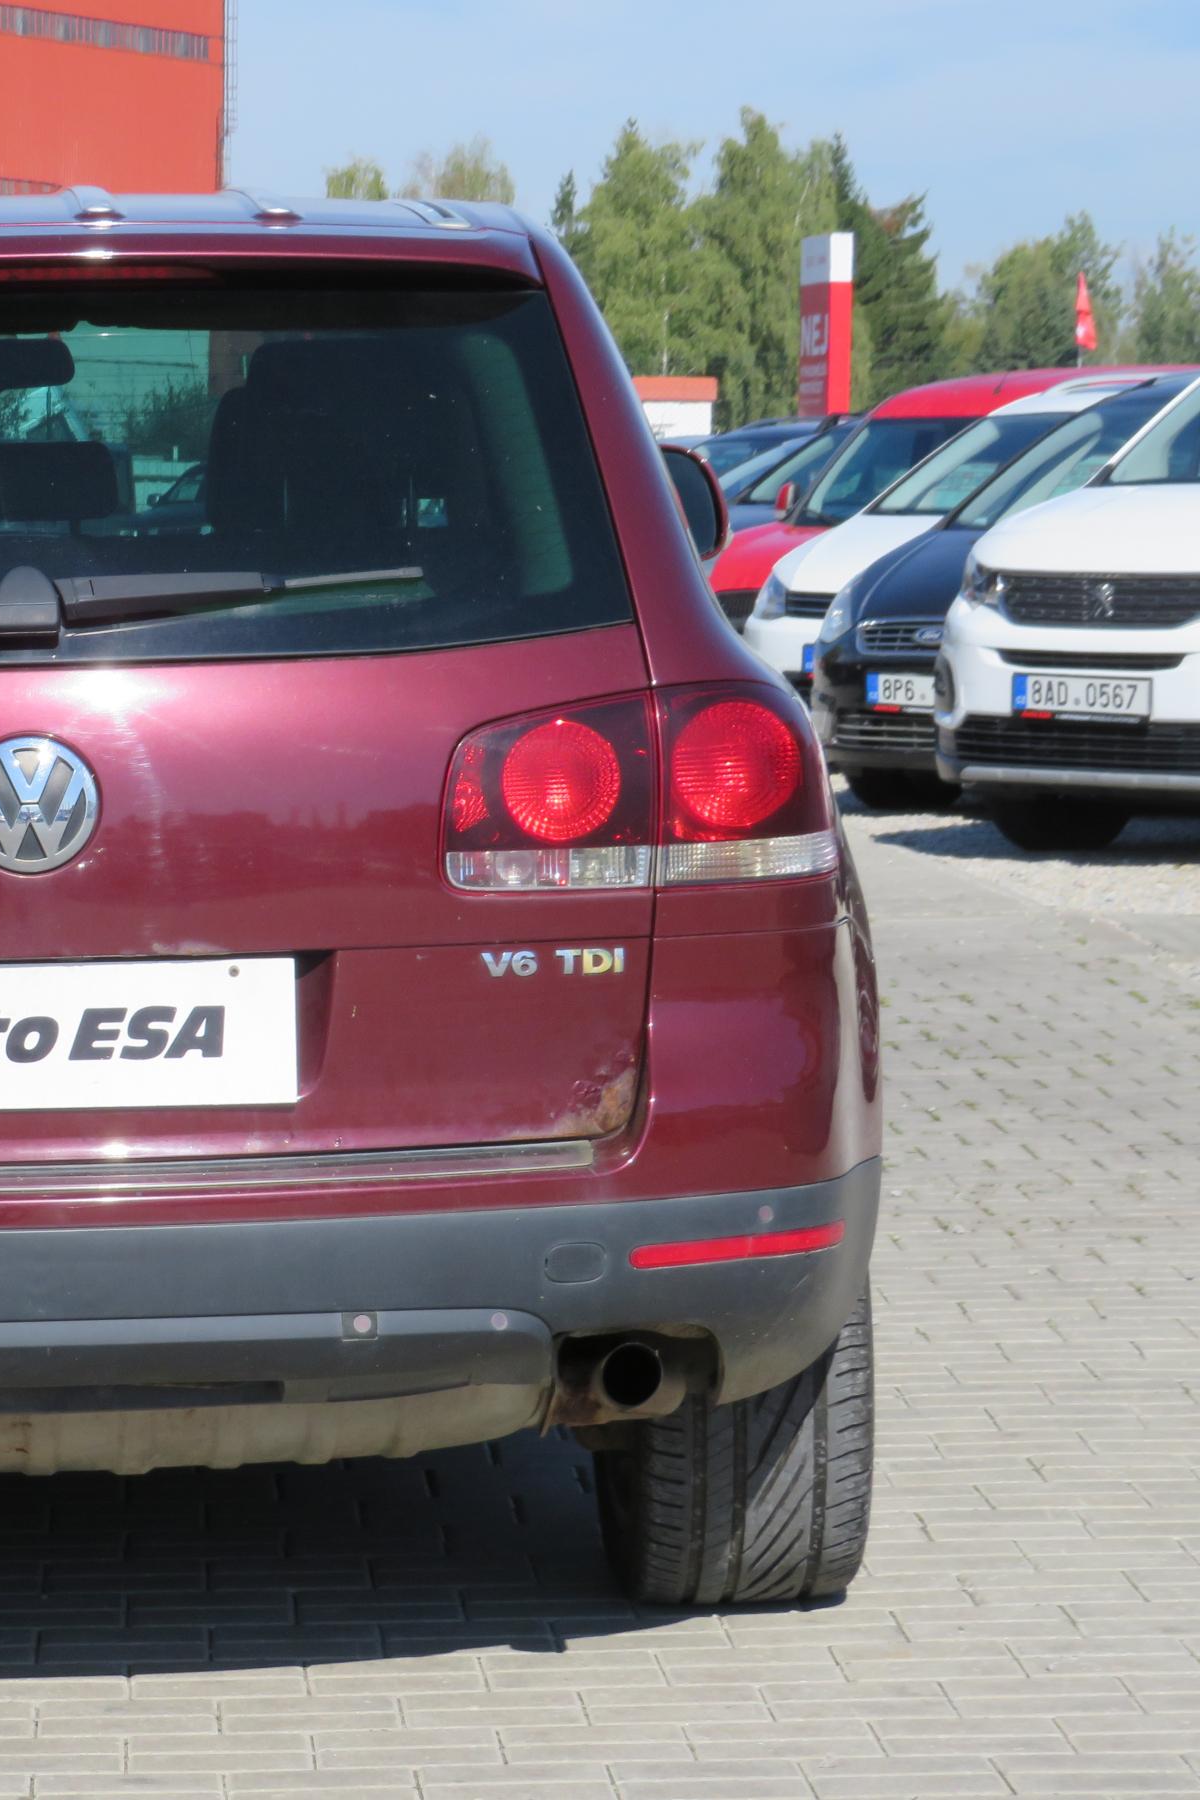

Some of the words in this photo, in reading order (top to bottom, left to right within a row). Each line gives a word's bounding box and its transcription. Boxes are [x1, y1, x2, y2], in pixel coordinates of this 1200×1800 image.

[801, 313, 828, 357] NEJ
[882, 678, 915, 701] 8P6
[1031, 680, 1068, 706] 8AD
[1086, 682, 1138, 709] 0567
[481, 951, 538, 977] V6
[556, 947, 625, 975] TDI
[68, 1005, 226, 1061] ESA
